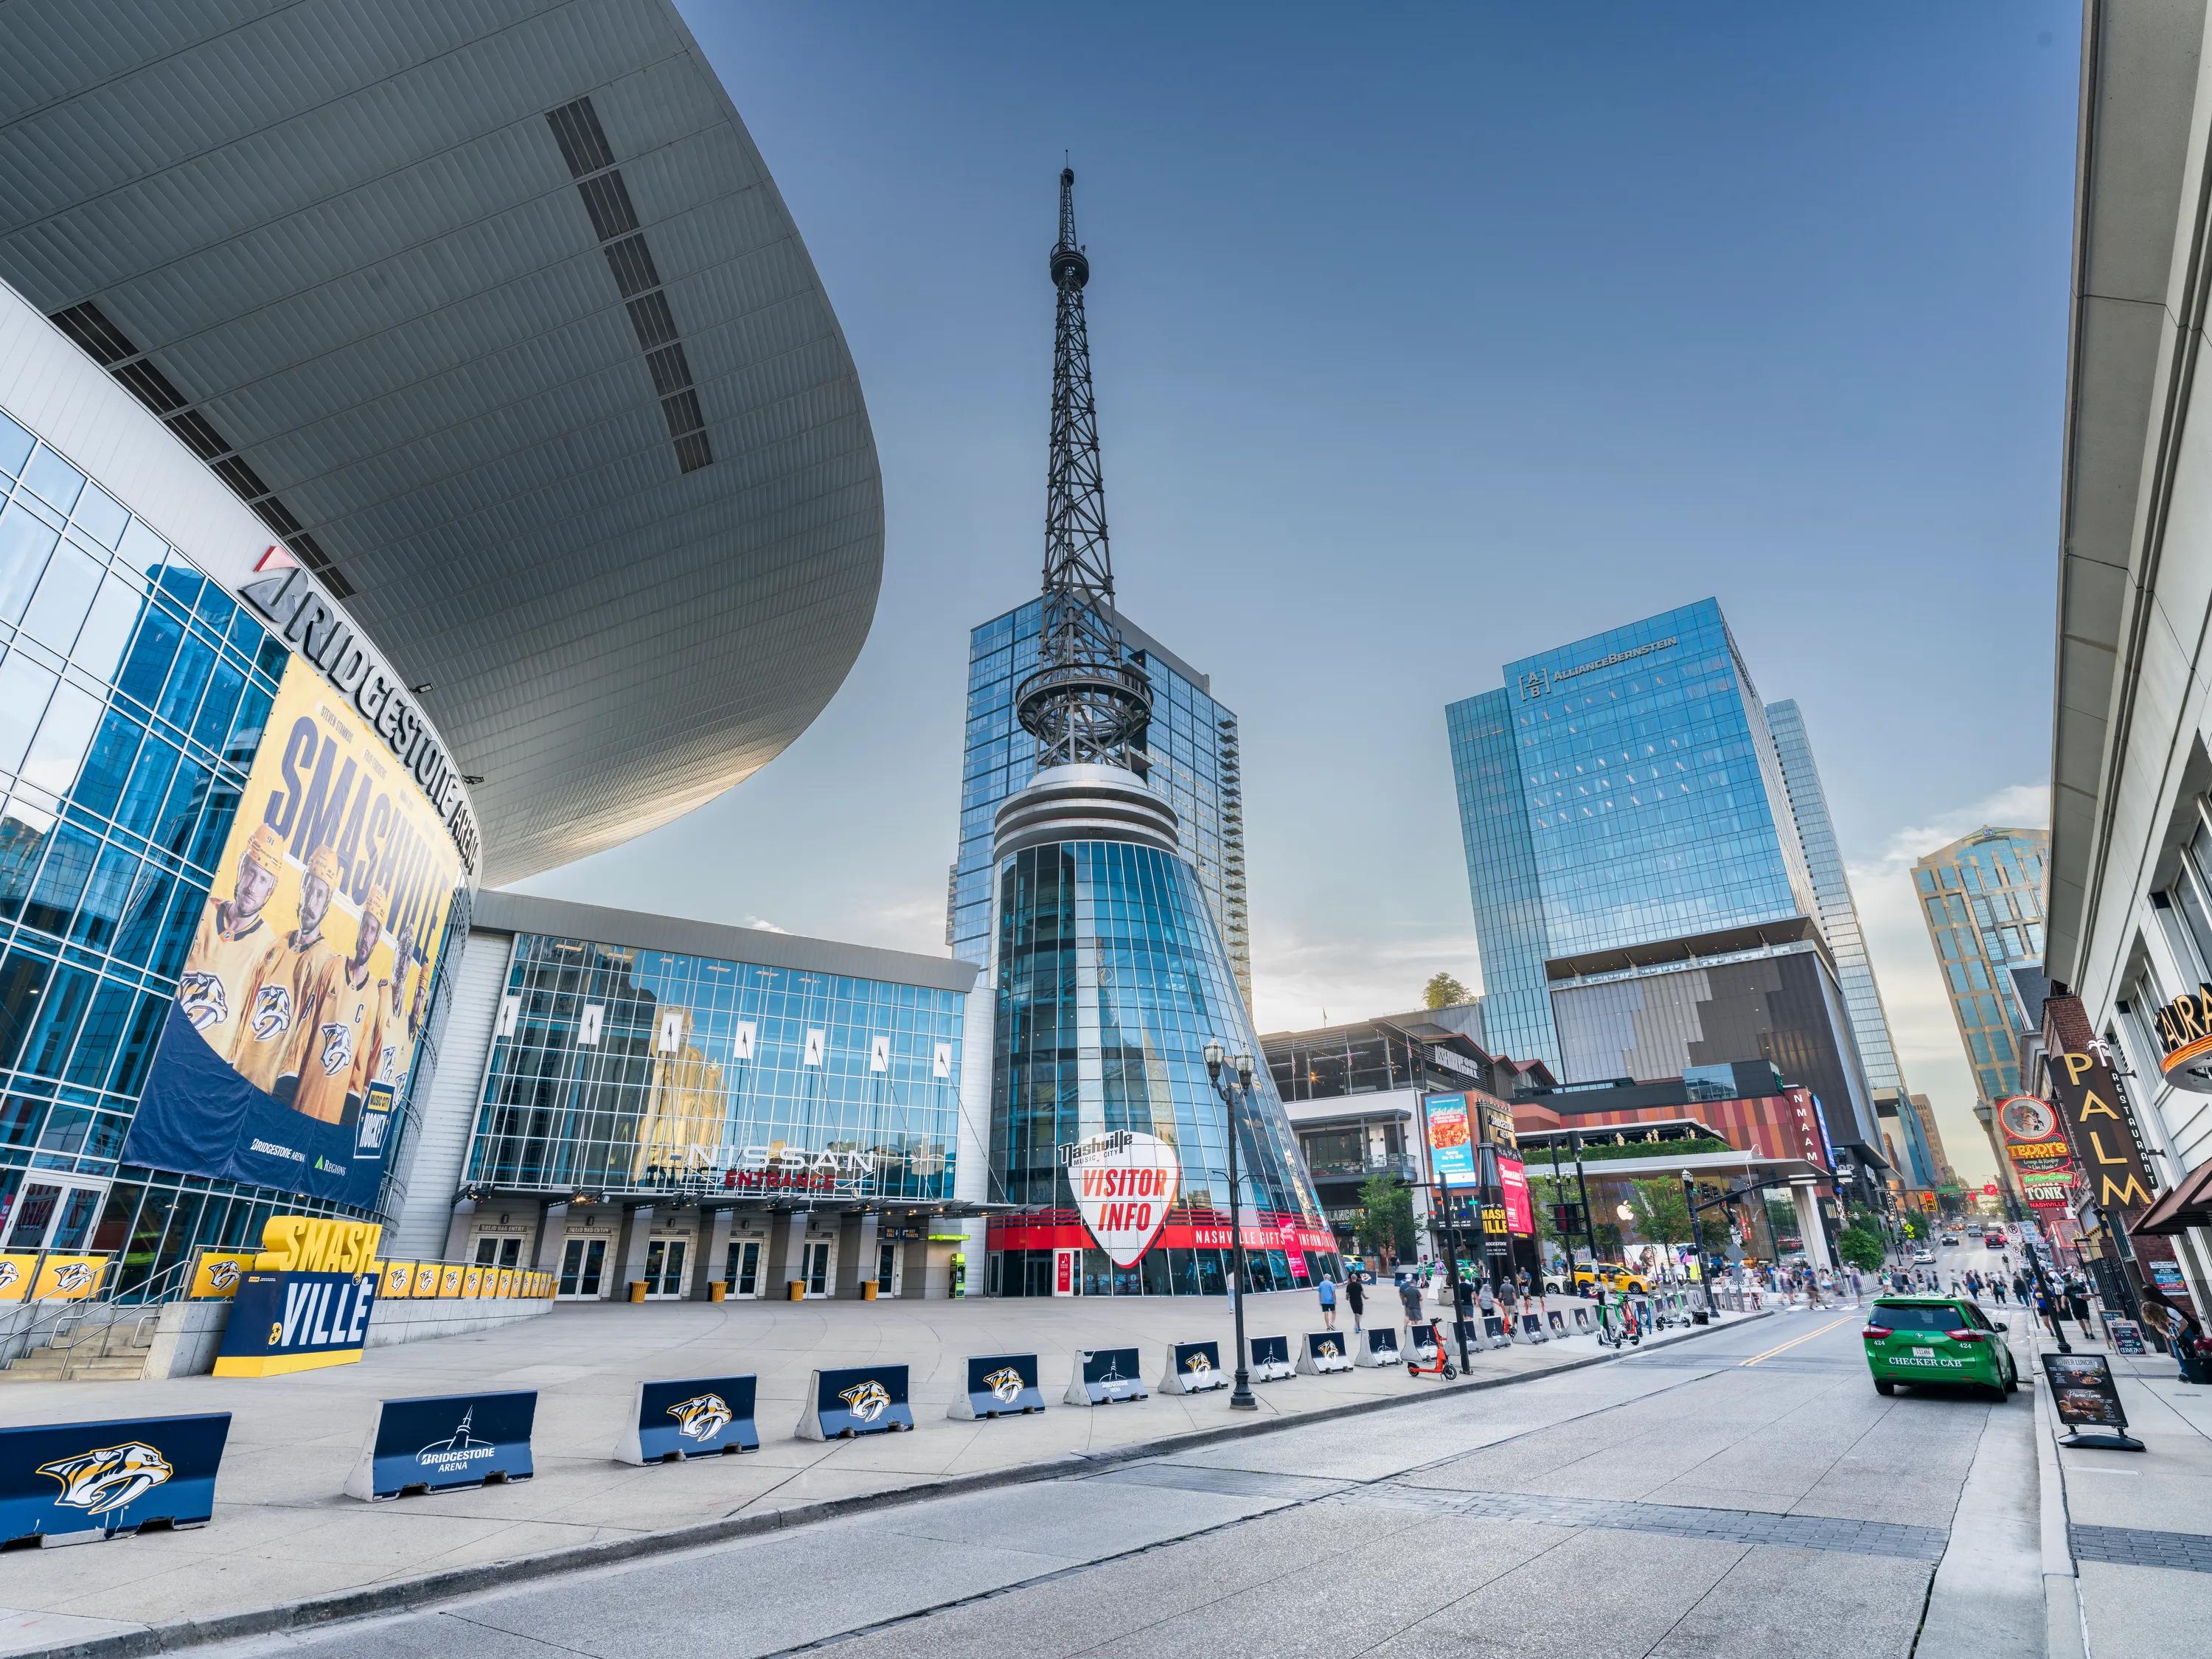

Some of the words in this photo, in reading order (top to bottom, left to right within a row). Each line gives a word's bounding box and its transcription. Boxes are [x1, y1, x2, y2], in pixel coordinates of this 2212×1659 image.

[237, 546, 462, 818] BRIDGESTONE
[448, 799, 481, 875] ARENA
[321, 706, 336, 728] STEVEN
[266, 836, 274, 846] 91
[1793, 1095, 1818, 1161] NMAAM
[2064, 1054, 2152, 1206] PALM
[2111, 1073, 2154, 1185] RESTAURANT
[250, 1138, 292, 1159] BRIDGESTONE
[291, 1152, 305, 1163] ARENA
[687, 1143, 875, 1172] NISSAN
[1059, 1130, 1133, 1167] Nashville
[1074, 1155, 1096, 1166] MUSIC
[1104, 1149, 1118, 1158] CITY
[2007, 1142, 2067, 1156] TEDDY'S
[725, 1170, 836, 1189] ENTRANCE
[1083, 1169, 1167, 1197] VISITOR
[2025, 1186, 2065, 1200] TONK
[1098, 1203, 1152, 1231] INFO
[1324, 1209, 1356, 1221] LANCO
[1481, 1209, 1506, 1220] MASH
[279, 1220, 383, 1273] SMASH
[1196, 1230, 1256, 1244] NASHVLLE
[1260, 1231, 1286, 1245] GIFTS
[281, 1283, 373, 1346] VILLE
[1889, 1357, 1938, 1366] CHECKER
[420, 1447, 495, 1466] BRIDGESTONE
[437, 1461, 468, 1472] ARENA
